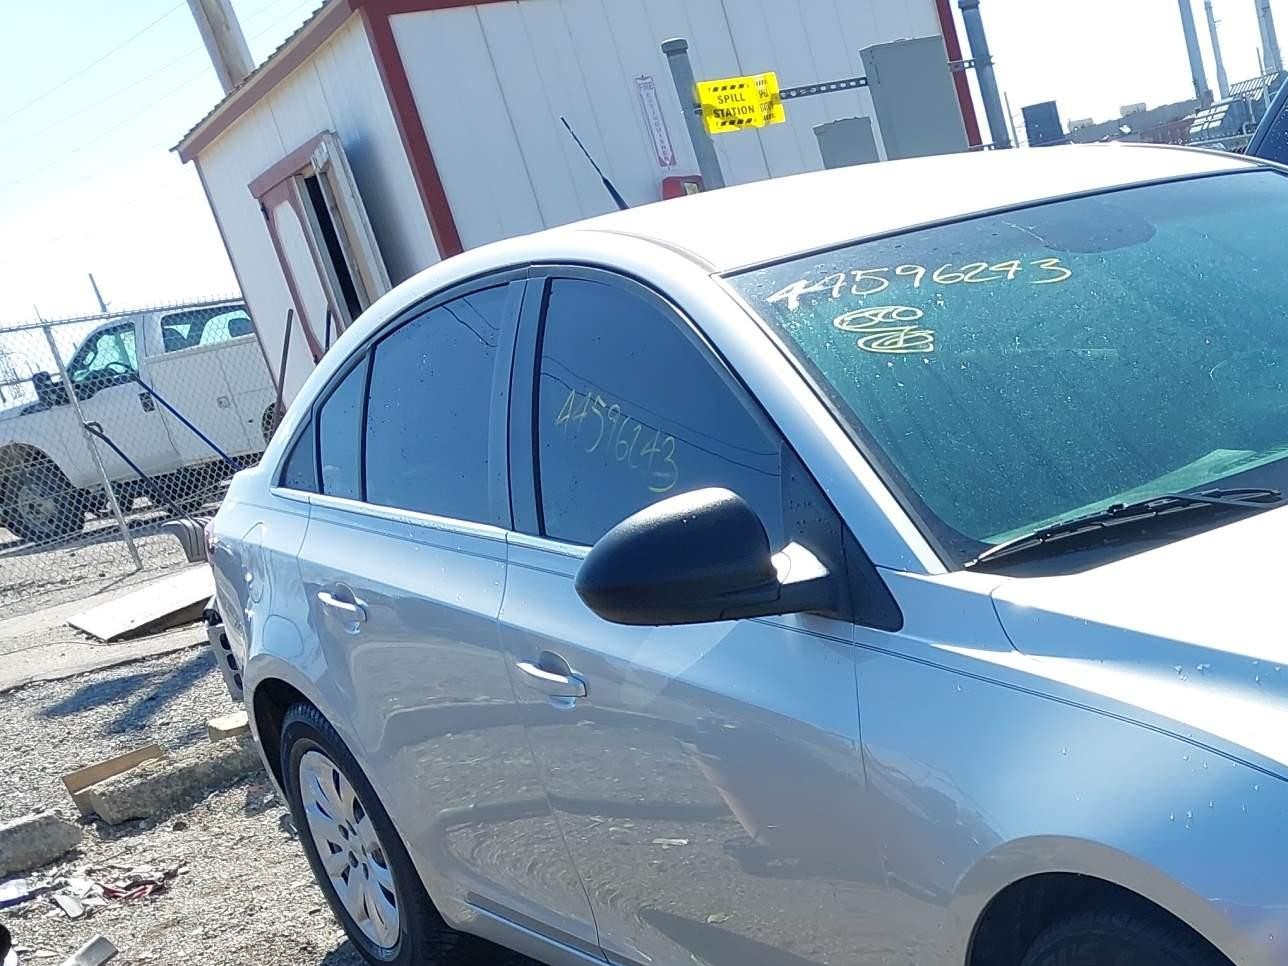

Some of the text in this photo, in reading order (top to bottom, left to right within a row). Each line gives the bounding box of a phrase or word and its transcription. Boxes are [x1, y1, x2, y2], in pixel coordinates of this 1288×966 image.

[717, 92, 746, 105] SPILL
[712, 104, 755, 118] STATION
[766, 257, 1073, 312] 44596243
